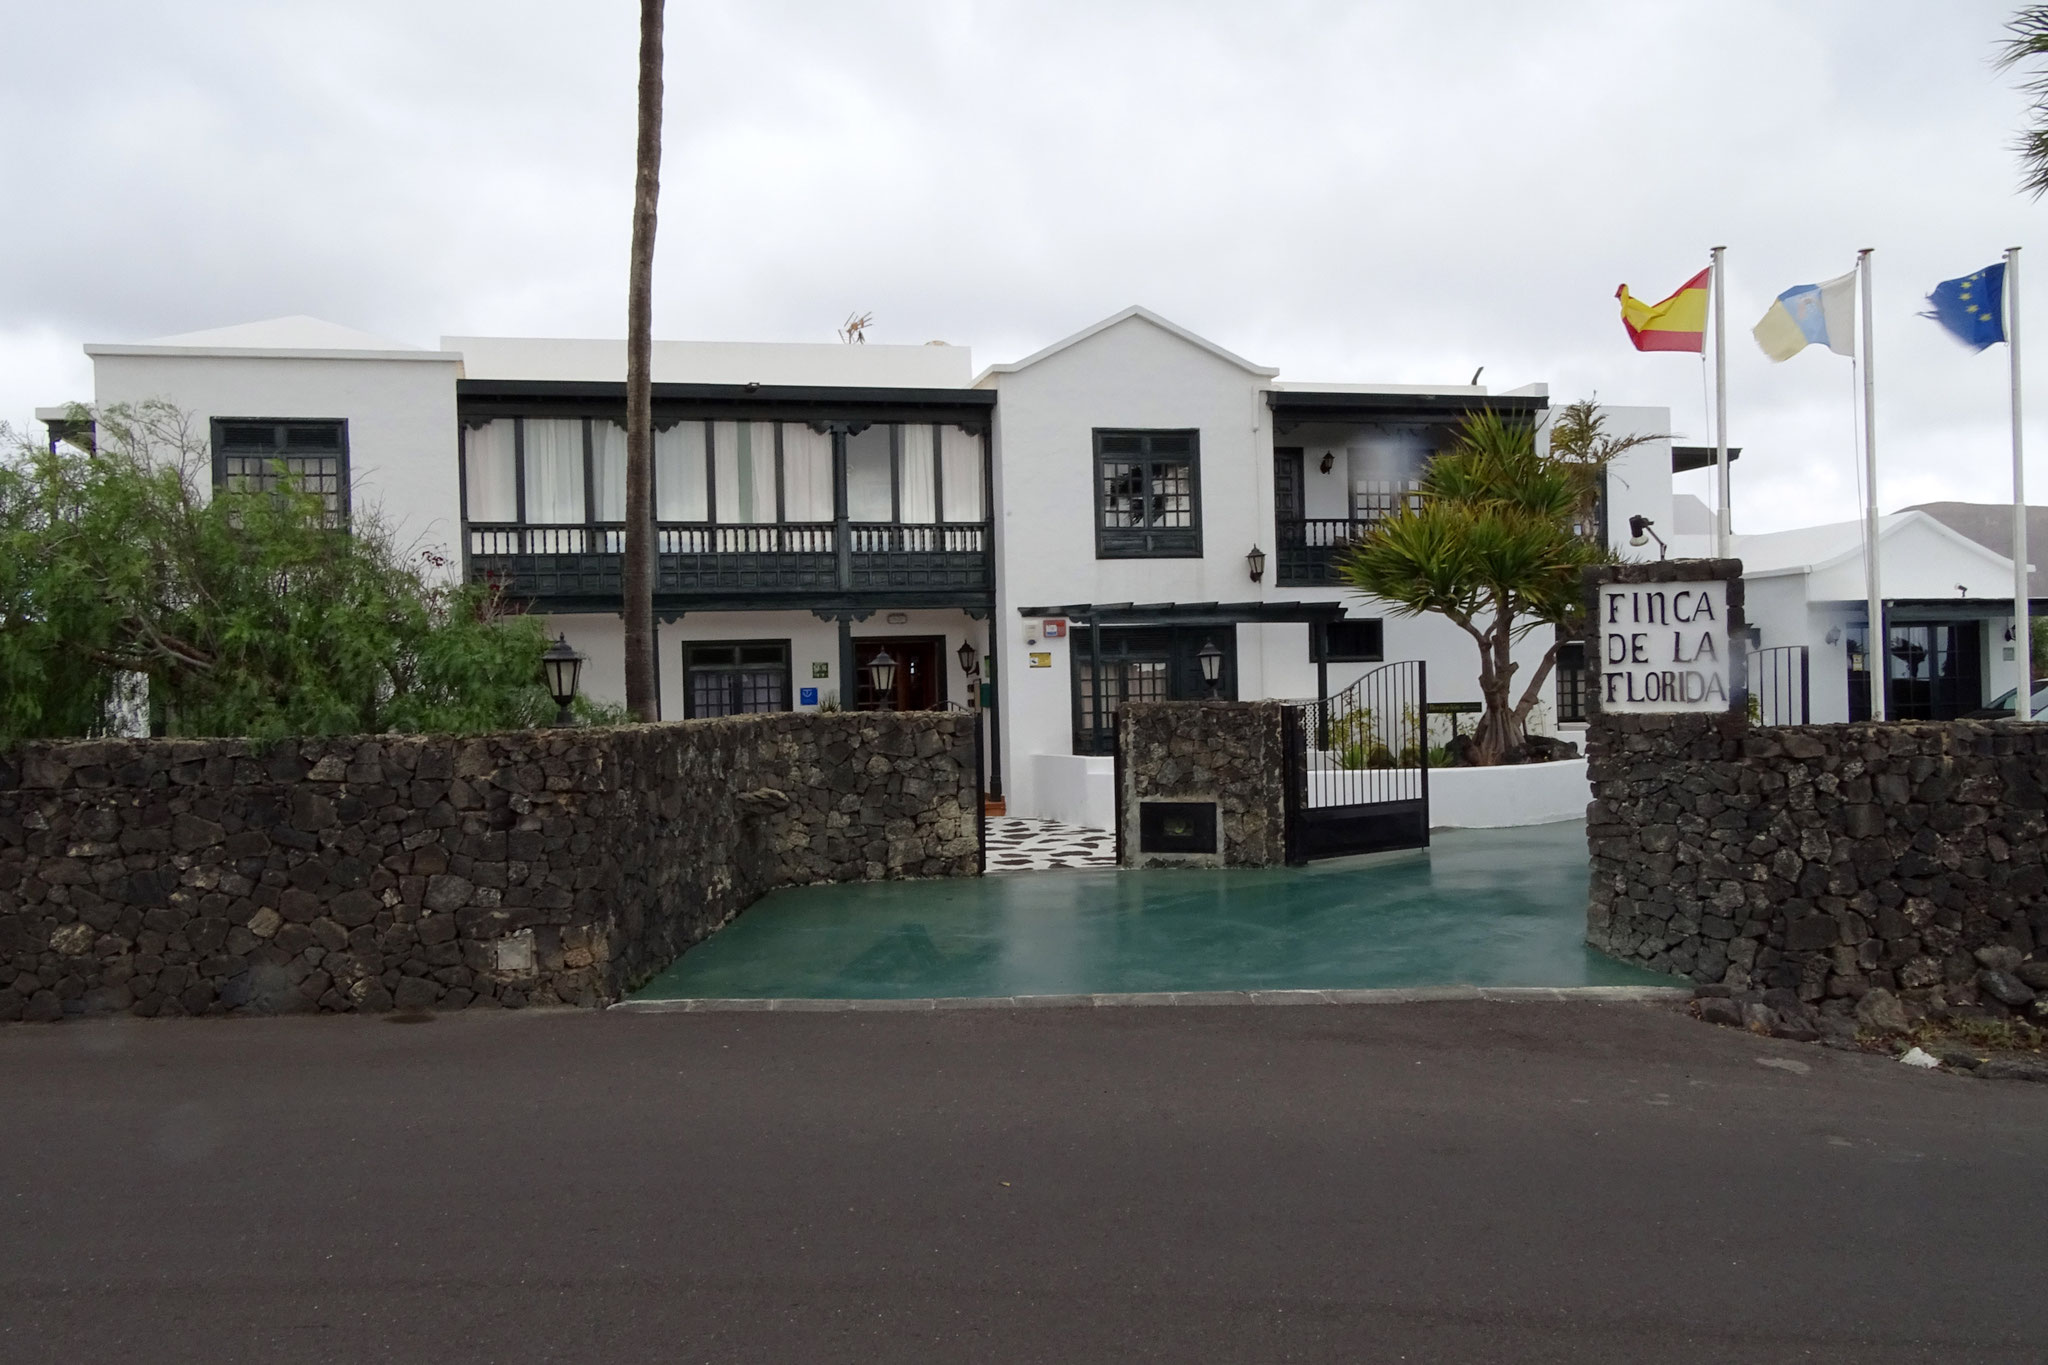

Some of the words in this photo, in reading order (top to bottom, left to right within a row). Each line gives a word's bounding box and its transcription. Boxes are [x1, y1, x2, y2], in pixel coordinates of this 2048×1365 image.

[1605, 591, 1715, 625] FINCA
[1608, 633, 1649, 665] DE
[1672, 631, 1718, 663] LA
[1602, 670, 1727, 703] FLORIDA
